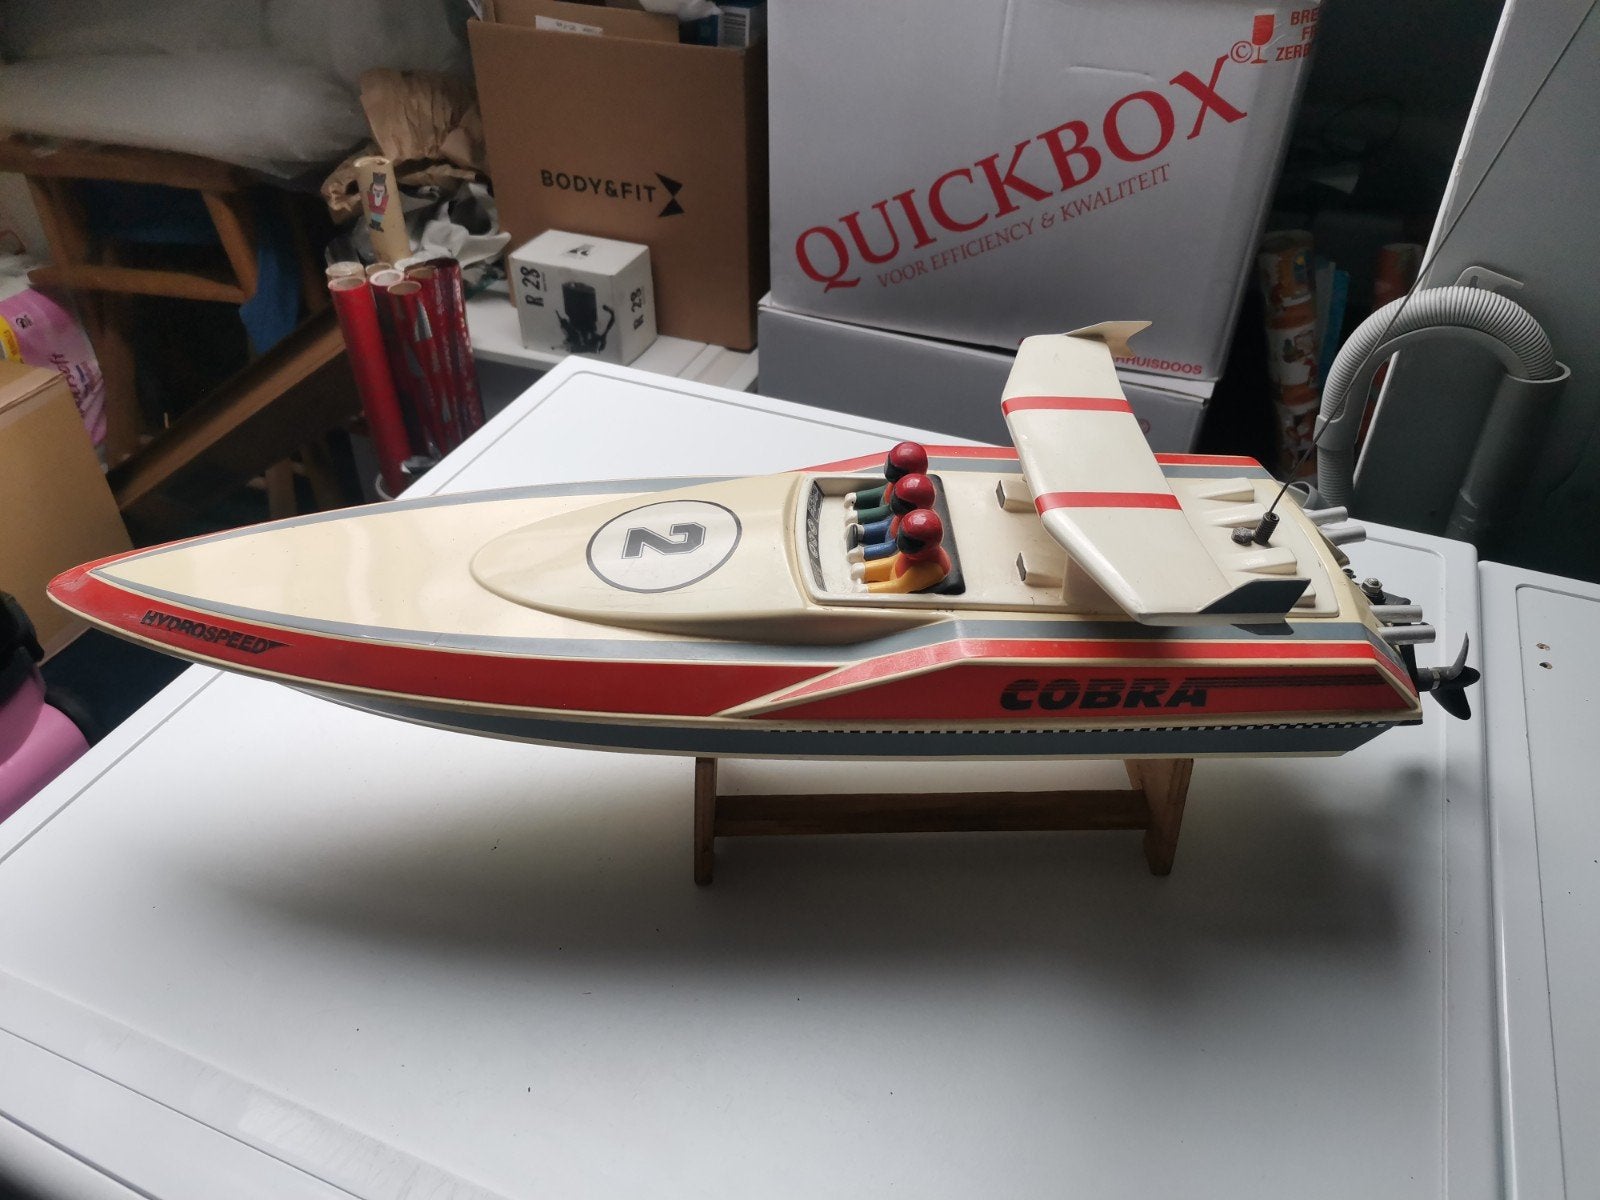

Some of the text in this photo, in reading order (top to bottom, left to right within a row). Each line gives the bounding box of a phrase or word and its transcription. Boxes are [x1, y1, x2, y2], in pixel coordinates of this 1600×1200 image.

[540, 169, 656, 202] BODY&FIT
[795, 54, 1247, 294] QUICKBOX
[876, 163, 1171, 288] VOOR EFFICIENCY & KWALITEIT
[621, 522, 706, 560] 2
[140, 609, 271, 655] HYDROSPEED
[1000, 678, 1207, 710] COBRA
